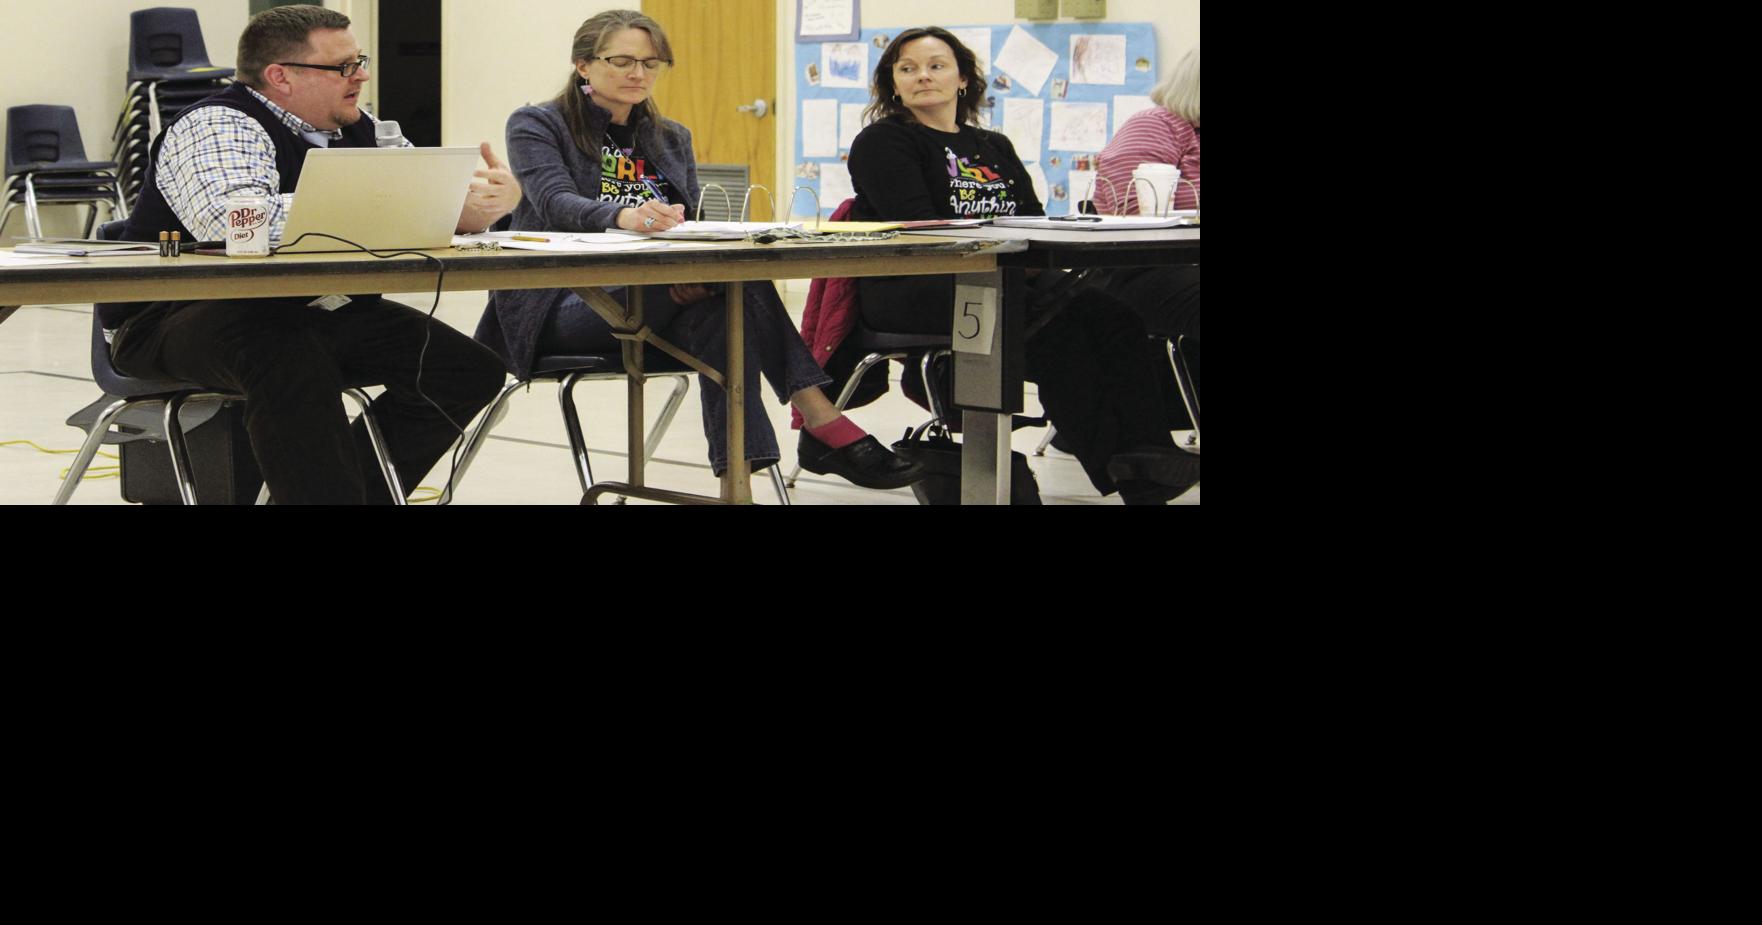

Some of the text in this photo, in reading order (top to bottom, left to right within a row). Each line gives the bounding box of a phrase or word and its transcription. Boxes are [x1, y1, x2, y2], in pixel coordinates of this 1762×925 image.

[228, 210, 266, 228] Pepper
[240, 207, 257, 219] Dr
[234, 232, 249, 240] Diet
[958, 301, 983, 340] 5
